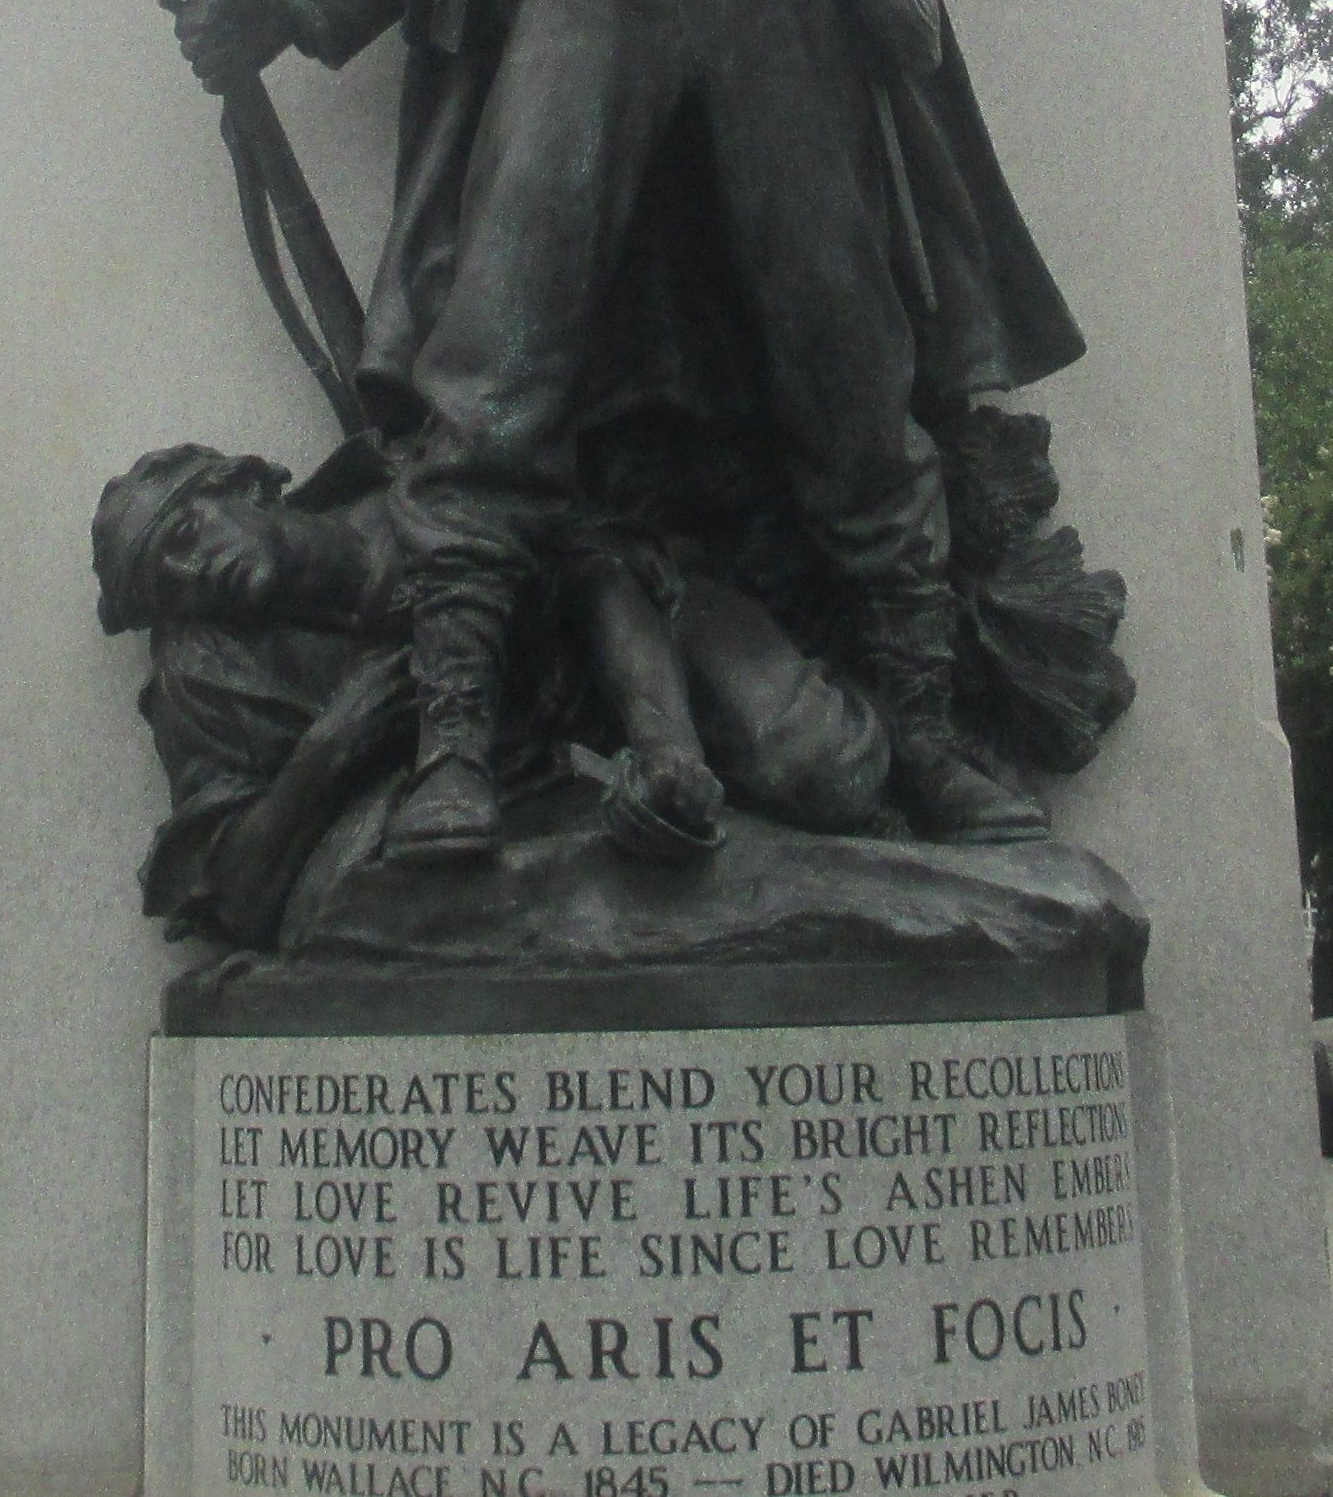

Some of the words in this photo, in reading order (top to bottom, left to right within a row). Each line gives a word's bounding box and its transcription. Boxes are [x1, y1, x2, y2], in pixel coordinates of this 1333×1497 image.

[220, 1071, 517, 1115] CONFEDERATES
[547, 1067, 716, 1113] BLEND
[745, 1062, 883, 1108] YOUR
[220, 1126, 263, 1166] LET
[279, 1126, 456, 1170] MEMORY
[485, 1122, 662, 1168] WEAVE
[690, 1119, 765, 1165] ITS
[792, 1112, 957, 1161] BRIGHT
[220, 1179, 268, 1220] LET
[294, 1180, 398, 1224] LOVE
[436, 1178, 637, 1225] REVIVE
[685, 1171, 843, 1220] LIFE'S
[886, 1164, 1027, 1213] ASHEN
[222, 1230, 274, 1274] FOR
[296, 1235, 396, 1278] LOVE
[425, 1236, 465, 1281] IS
[496, 1235, 606, 1280] LIFE
[639, 1230, 794, 1278] SINCE
[825, 1222, 945, 1270] LOVE
[324, 1316, 453, 1381] PRO
[516, 1314, 725, 1381] ARIS
[789, 1309, 874, 1375] ET
[931, 1289, 1088, 1364] FOCIS
[220, 1403, 266, 1442] THIS
[280, 1411, 471, 1454] MONUMENT
[493, 1419, 525, 1455] IS
[548, 1421, 578, 1455] A
[601, 1415, 766, 1455] LEGACY
[788, 1413, 837, 1449] OF
[856, 1400, 1008, 1445] GABRIEL
[1023, 1383, 1100, 1430] JAMES
[227, 1449, 288, 1488] BORN
[585, 1465, 667, 1497] 1845
[767, 1459, 855, 1497] DIED
